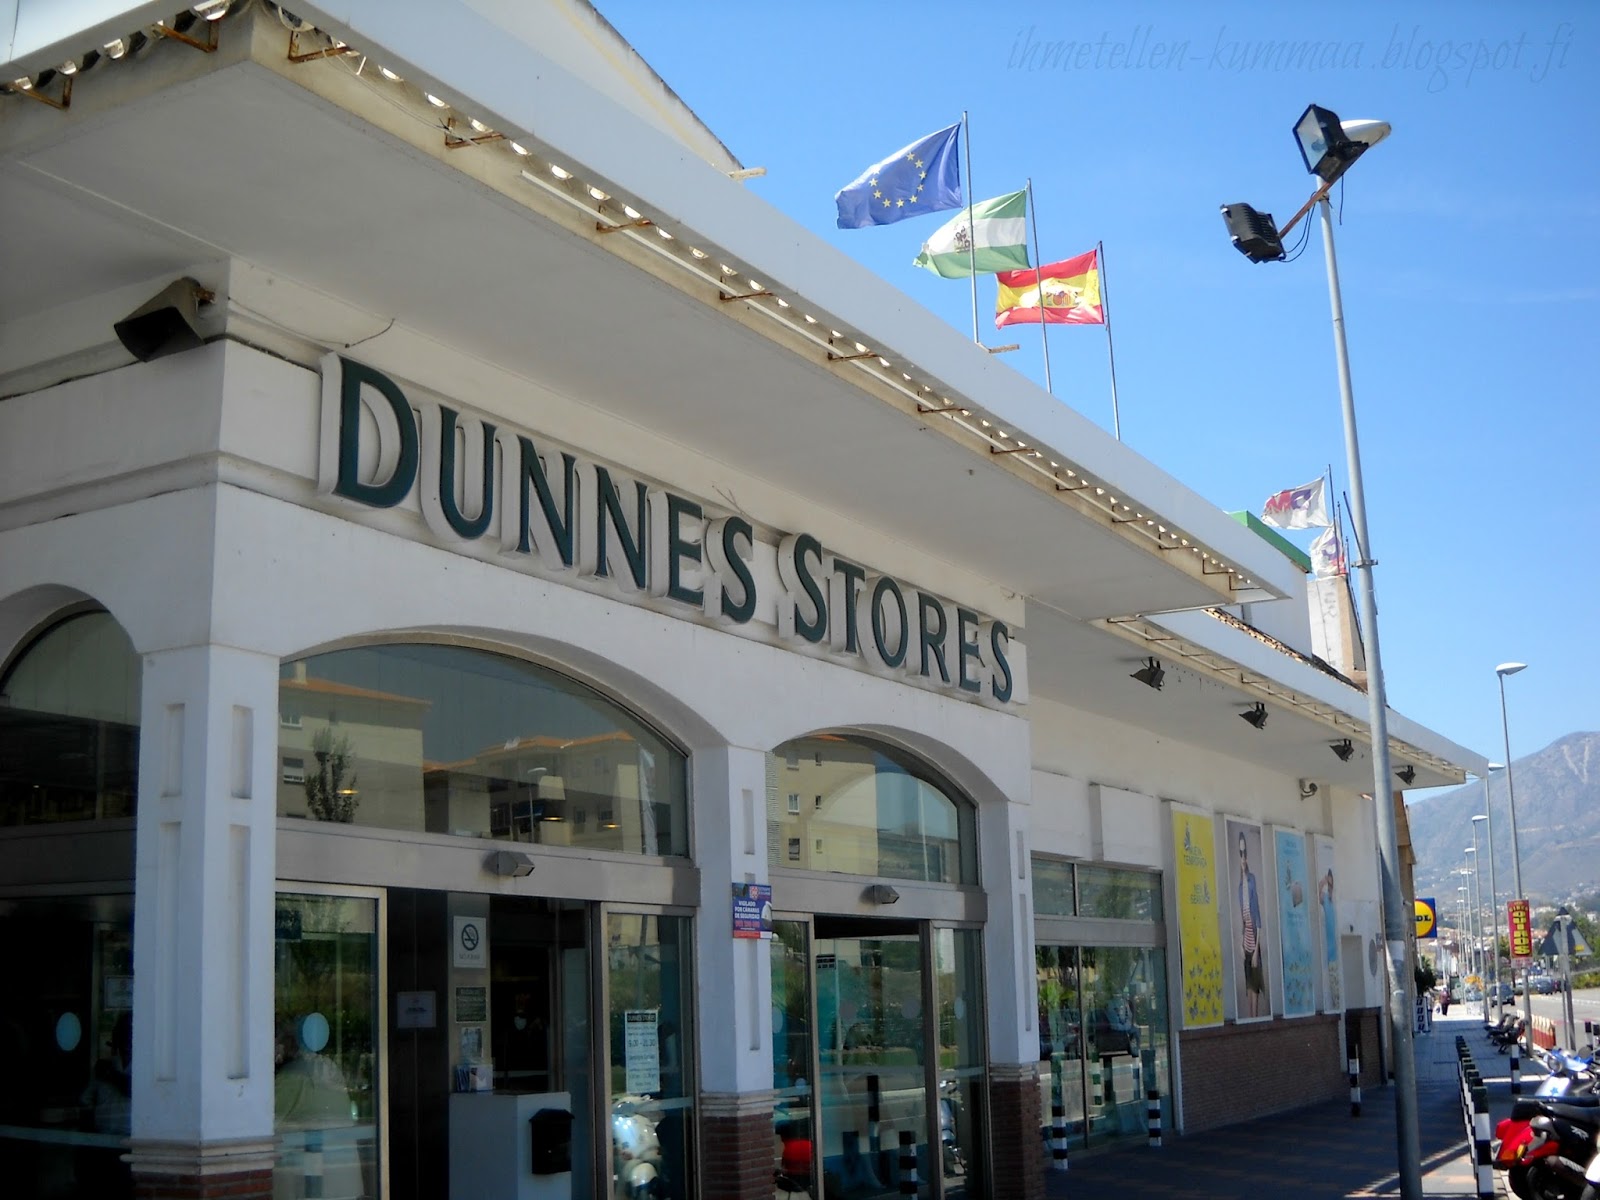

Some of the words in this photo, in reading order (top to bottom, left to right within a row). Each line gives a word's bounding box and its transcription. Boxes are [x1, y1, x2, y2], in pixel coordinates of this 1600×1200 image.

[318, 351, 757, 624] DUNNES
[777, 533, 1013, 703] STORES
[1415, 914, 1432, 922] DL
